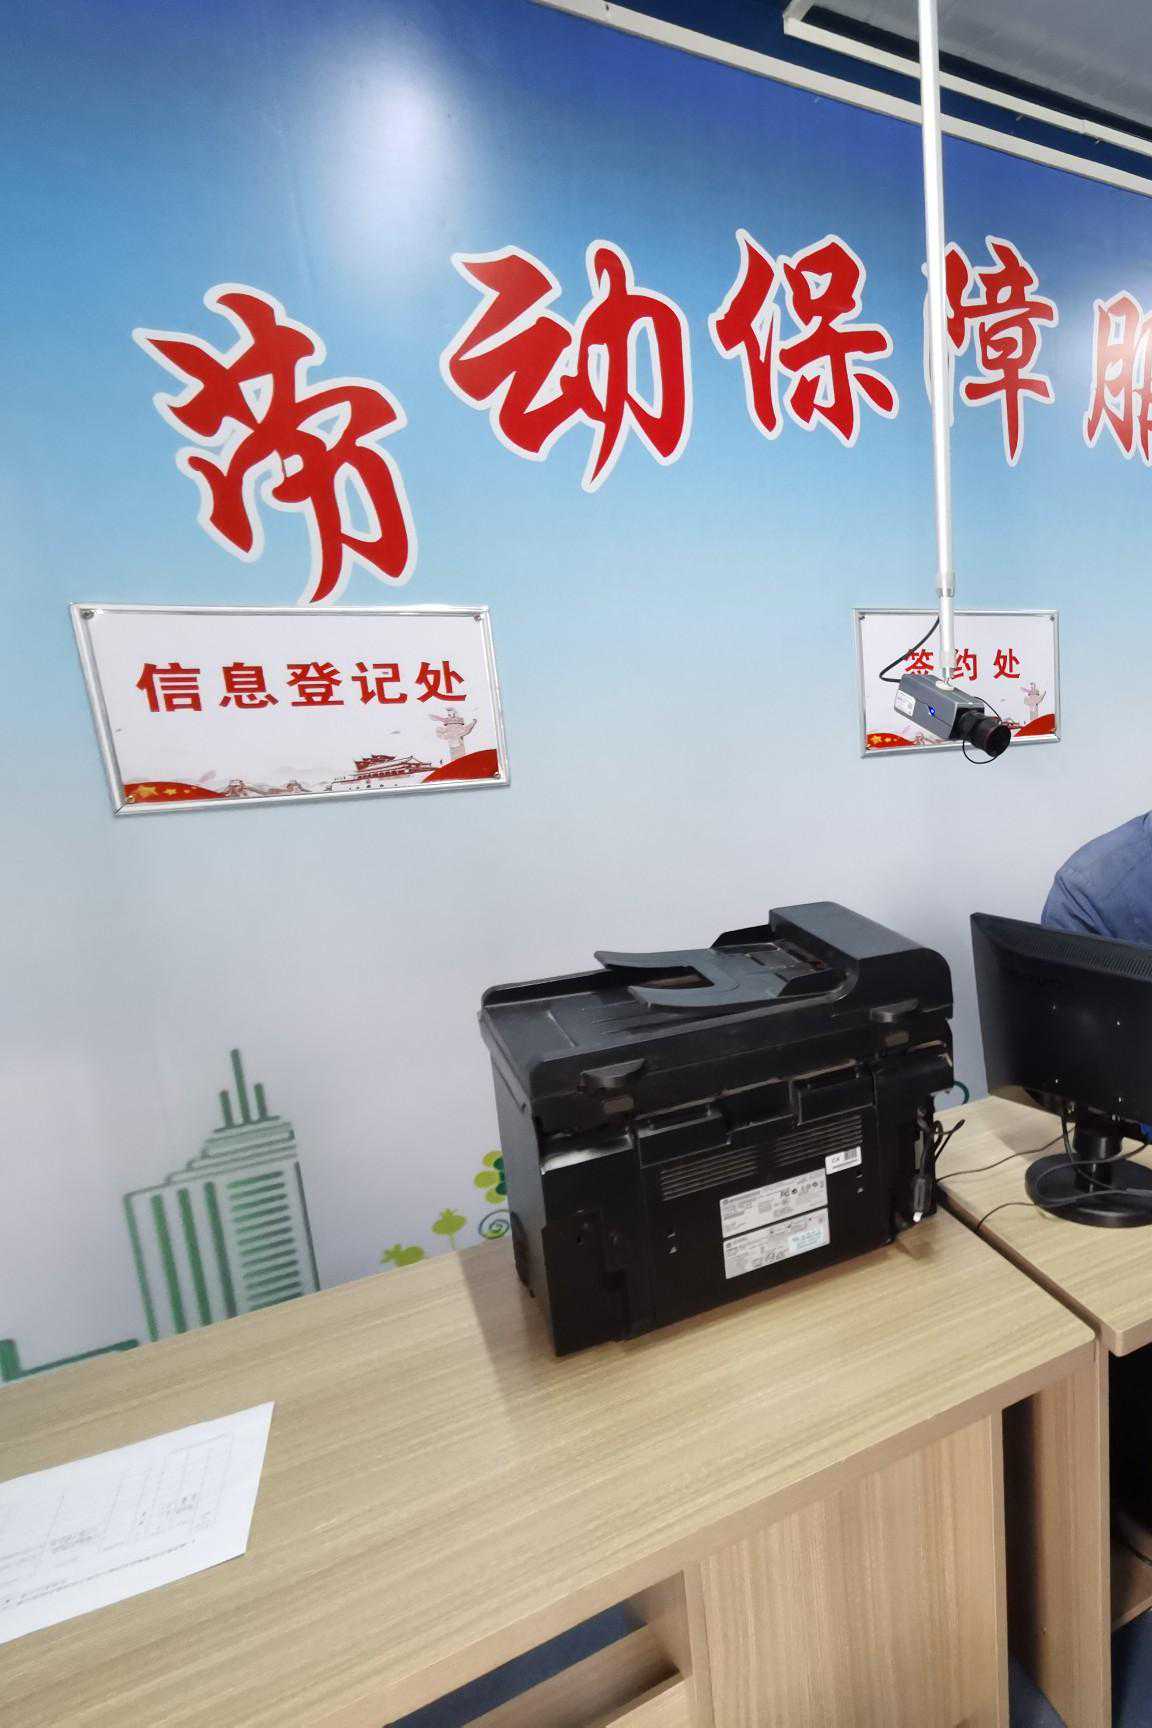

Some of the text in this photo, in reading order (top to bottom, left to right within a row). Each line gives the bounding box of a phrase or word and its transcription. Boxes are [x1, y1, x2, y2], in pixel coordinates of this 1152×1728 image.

[904, 648, 1021, 681] 签约处
[136, 660, 468, 713] 信息登记处
